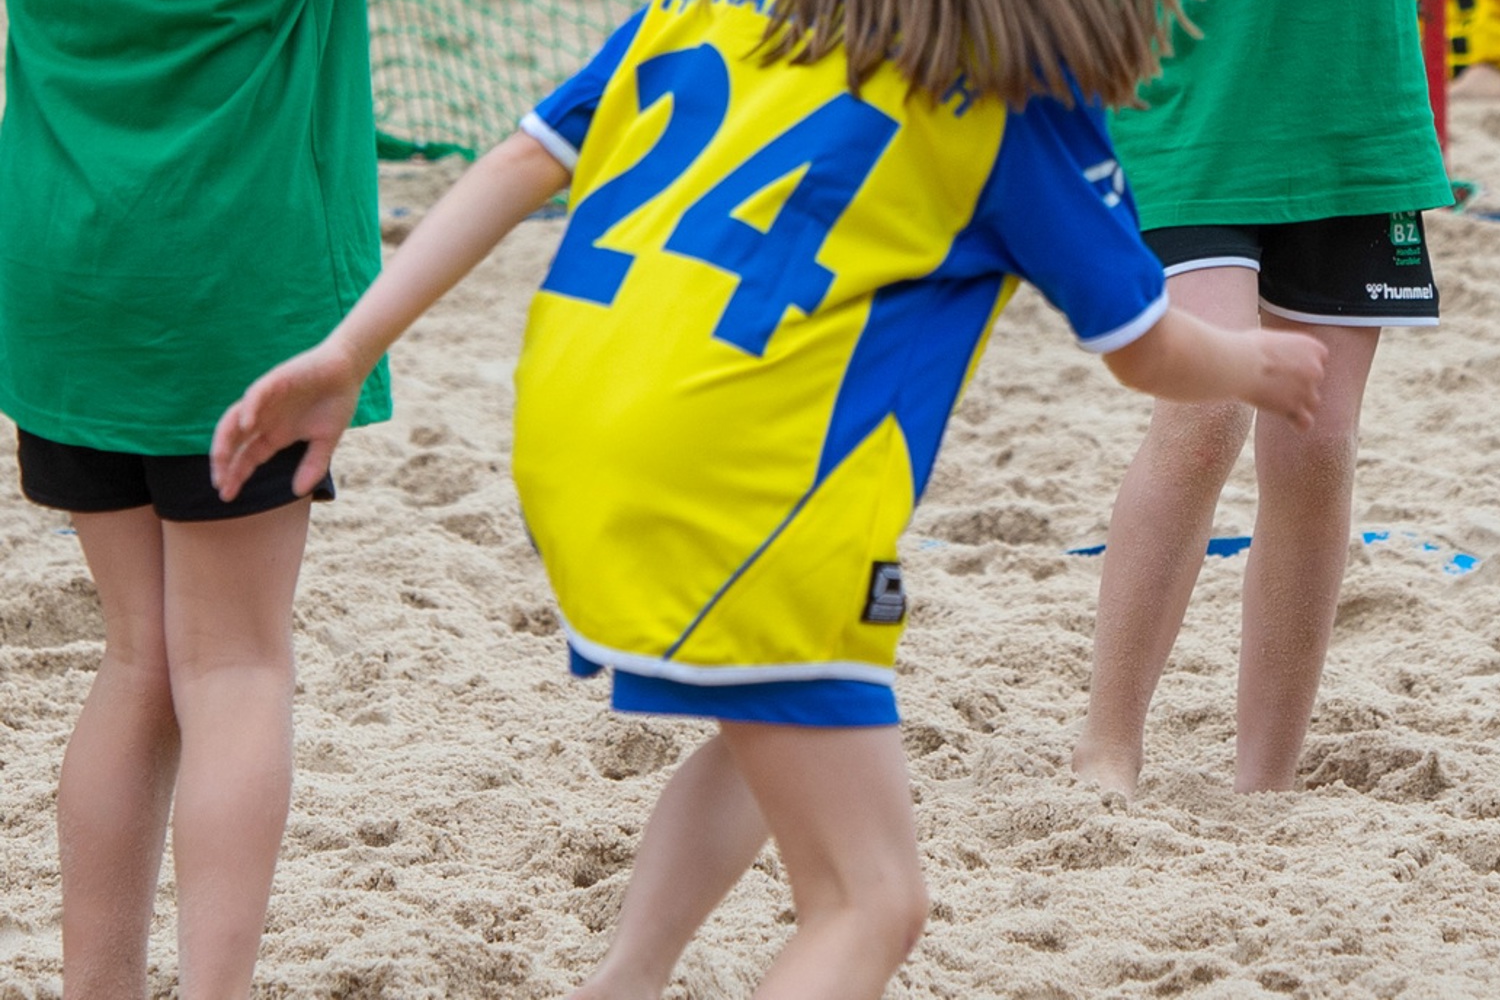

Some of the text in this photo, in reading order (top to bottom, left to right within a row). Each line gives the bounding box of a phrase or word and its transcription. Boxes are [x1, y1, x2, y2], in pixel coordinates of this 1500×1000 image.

[541, 41, 902, 358] 24
[1393, 222, 1419, 243] BZ
[1383, 283, 1434, 300] hummel
